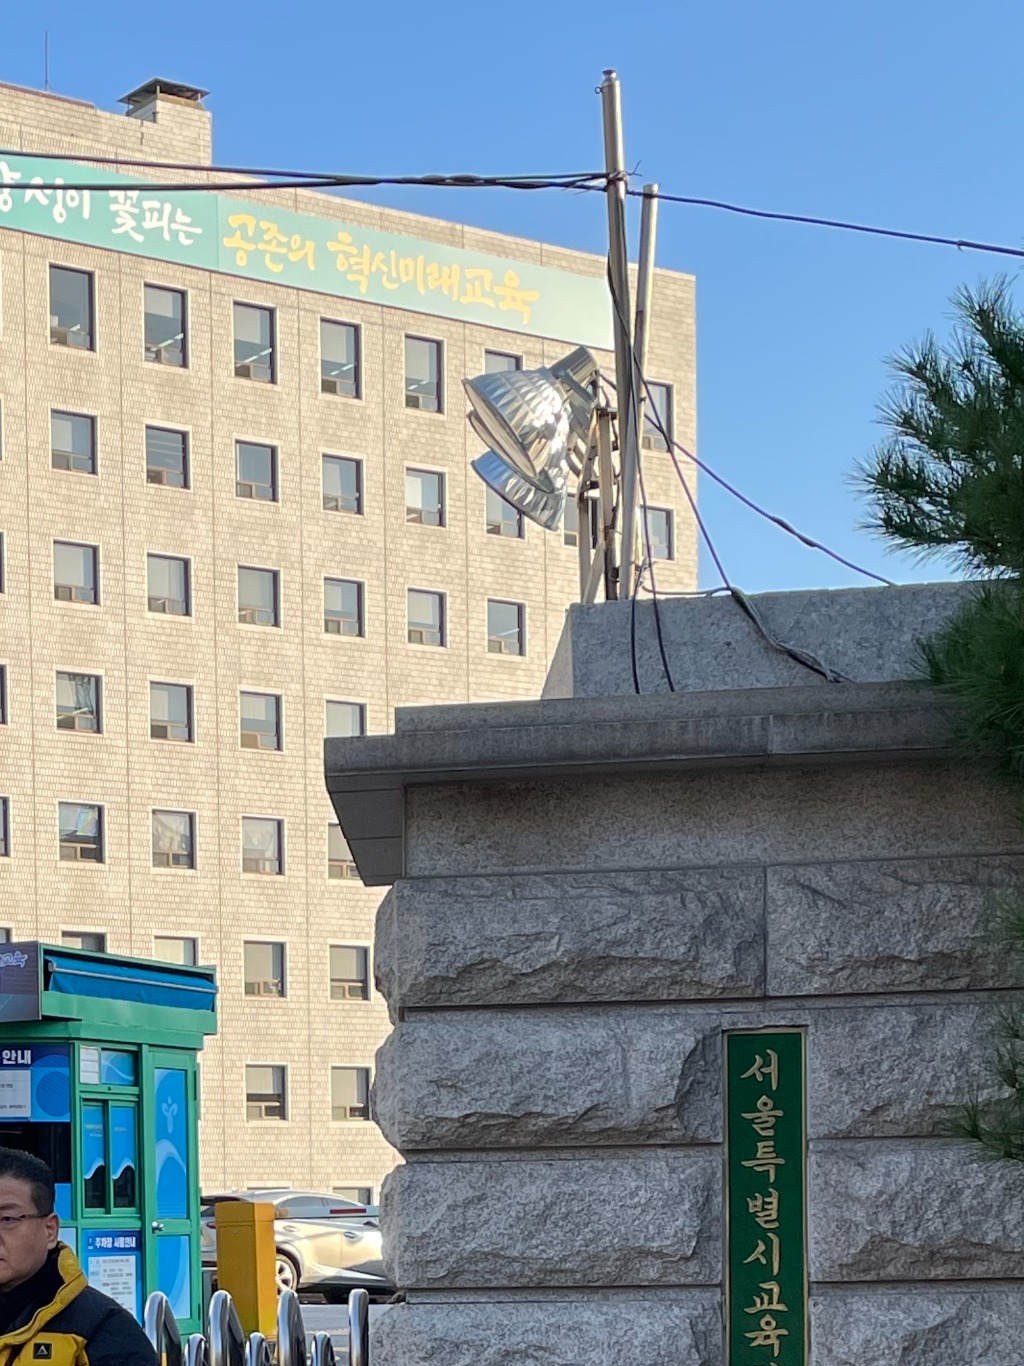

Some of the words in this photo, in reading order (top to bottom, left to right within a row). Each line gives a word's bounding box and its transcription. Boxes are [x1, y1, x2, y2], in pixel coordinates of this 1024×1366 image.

[108, 188, 204, 245] 꽃피는
[223, 211, 317, 273] 공존의
[327, 230, 540, 325] 혁신미래교육
